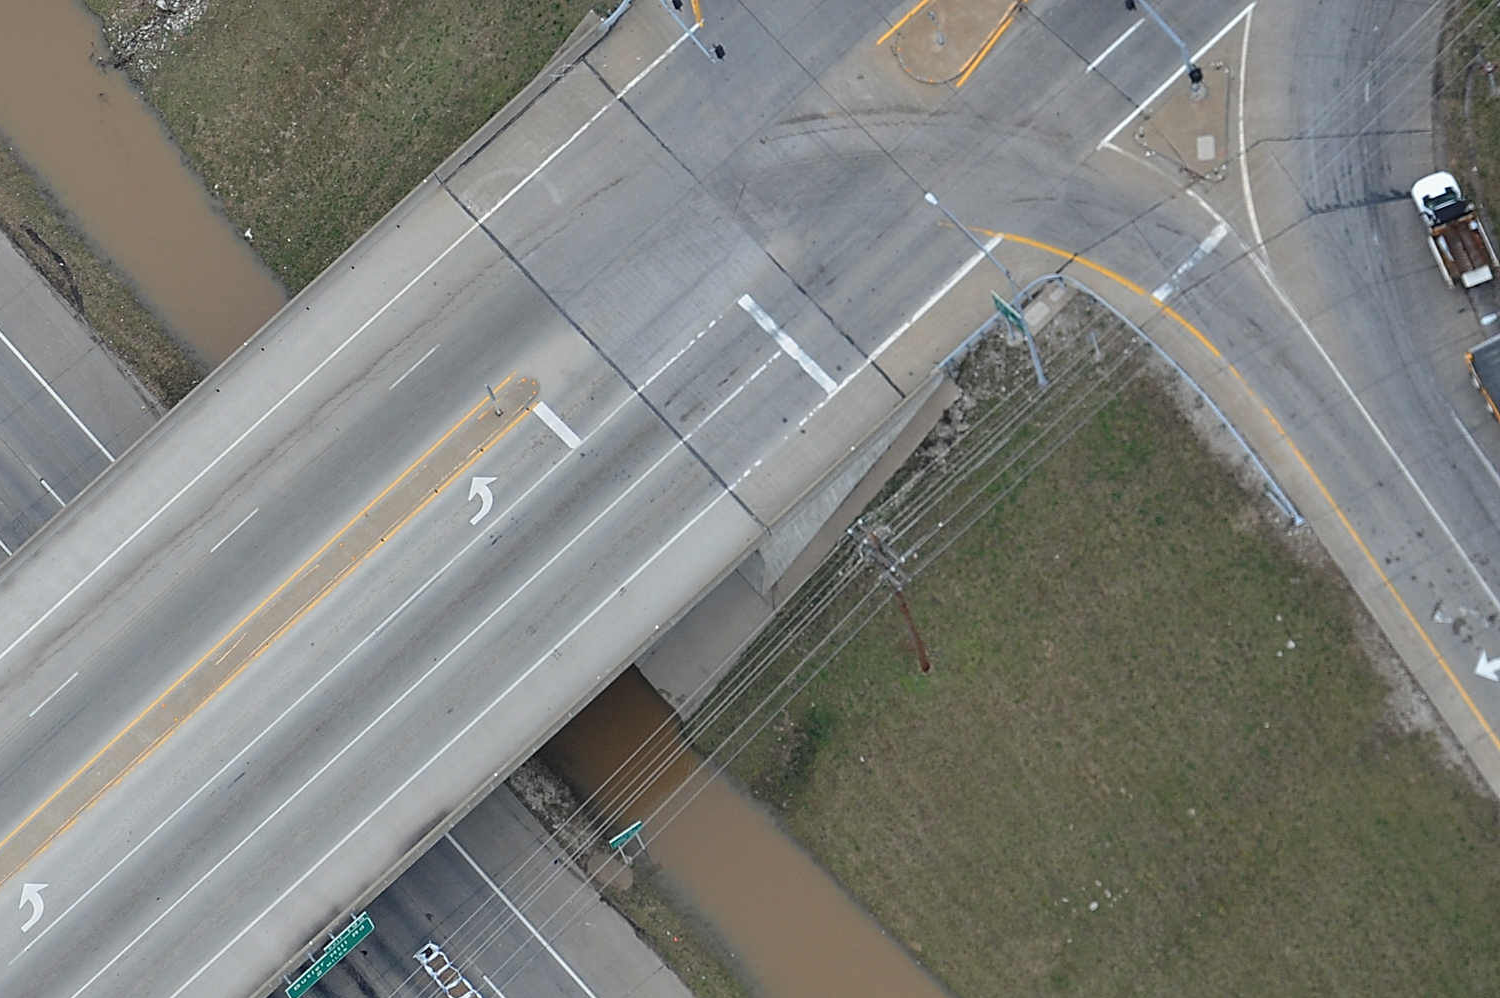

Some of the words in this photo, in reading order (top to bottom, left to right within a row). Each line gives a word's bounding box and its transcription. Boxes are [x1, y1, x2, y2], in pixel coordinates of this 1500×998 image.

[293, 962, 325, 991] Butler
[330, 940, 348, 958] Hill
[351, 925, 365, 938] Rd
[326, 948, 348, 967] MILES
